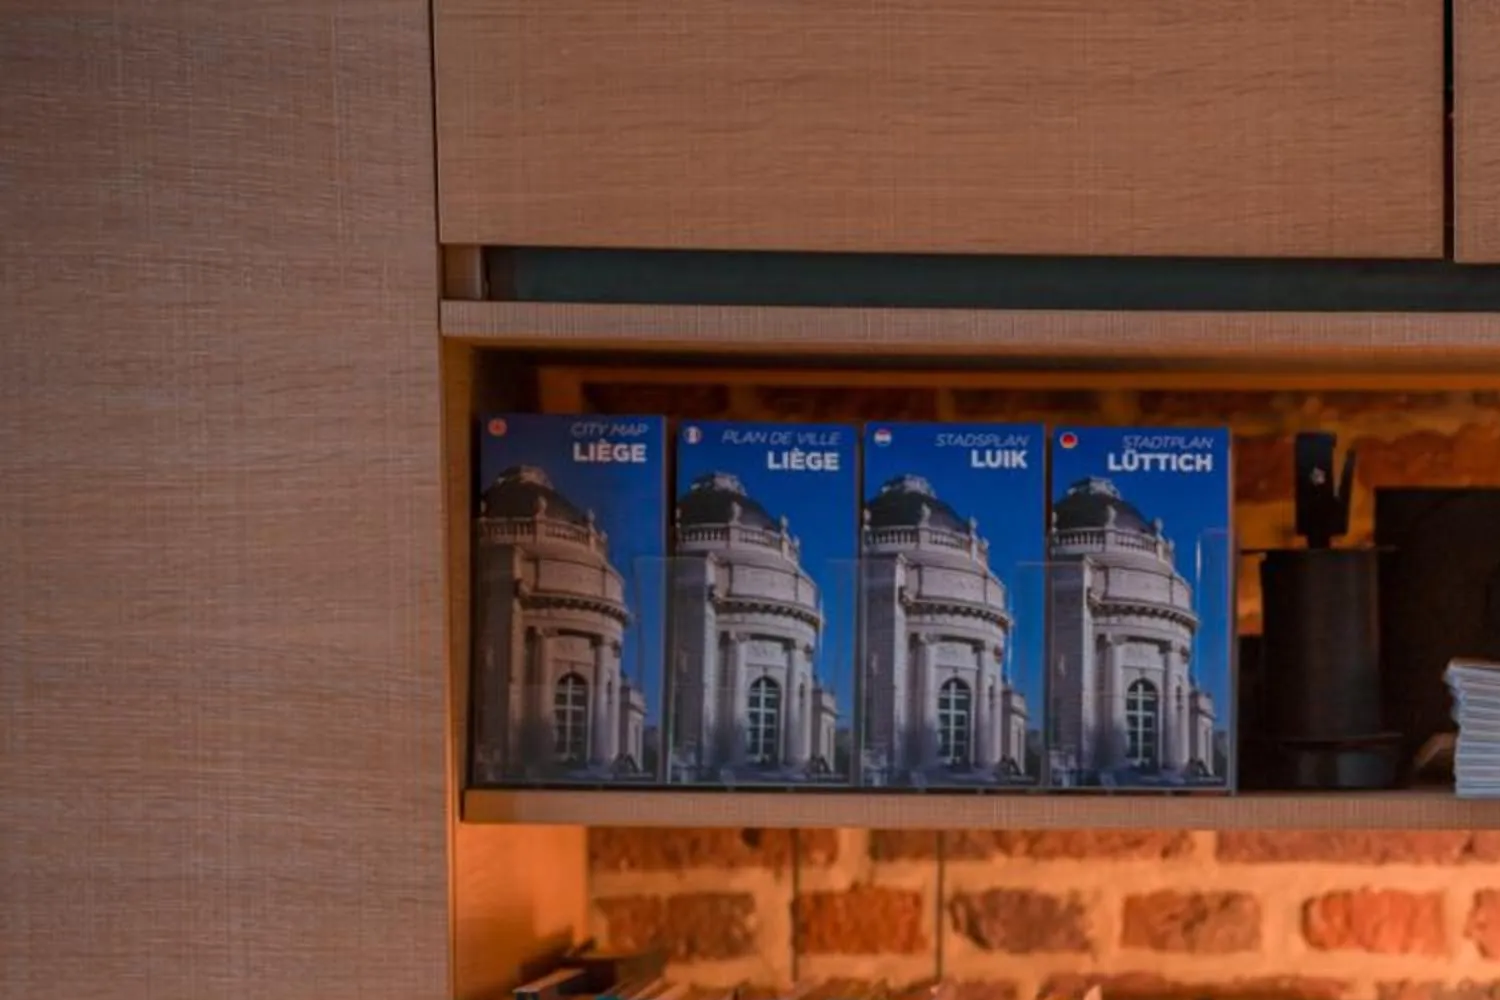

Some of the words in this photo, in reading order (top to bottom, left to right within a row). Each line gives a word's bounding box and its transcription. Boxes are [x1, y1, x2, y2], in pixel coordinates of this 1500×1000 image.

[570, 422, 608, 437] CITY
[610, 423, 649, 437] MAP
[722, 429, 766, 445] PLAN
[769, 430, 792, 445] DE
[797, 431, 841, 446] VILLE
[935, 433, 1030, 447] STADSPLAN
[1122, 434, 1215, 449] STADTPLAN
[573, 440, 648, 463] LIÈGE
[767, 448, 840, 471] LIÈGE
[970, 449, 1029, 469] LUIK
[1107, 450, 1213, 472] LÜTTICH
